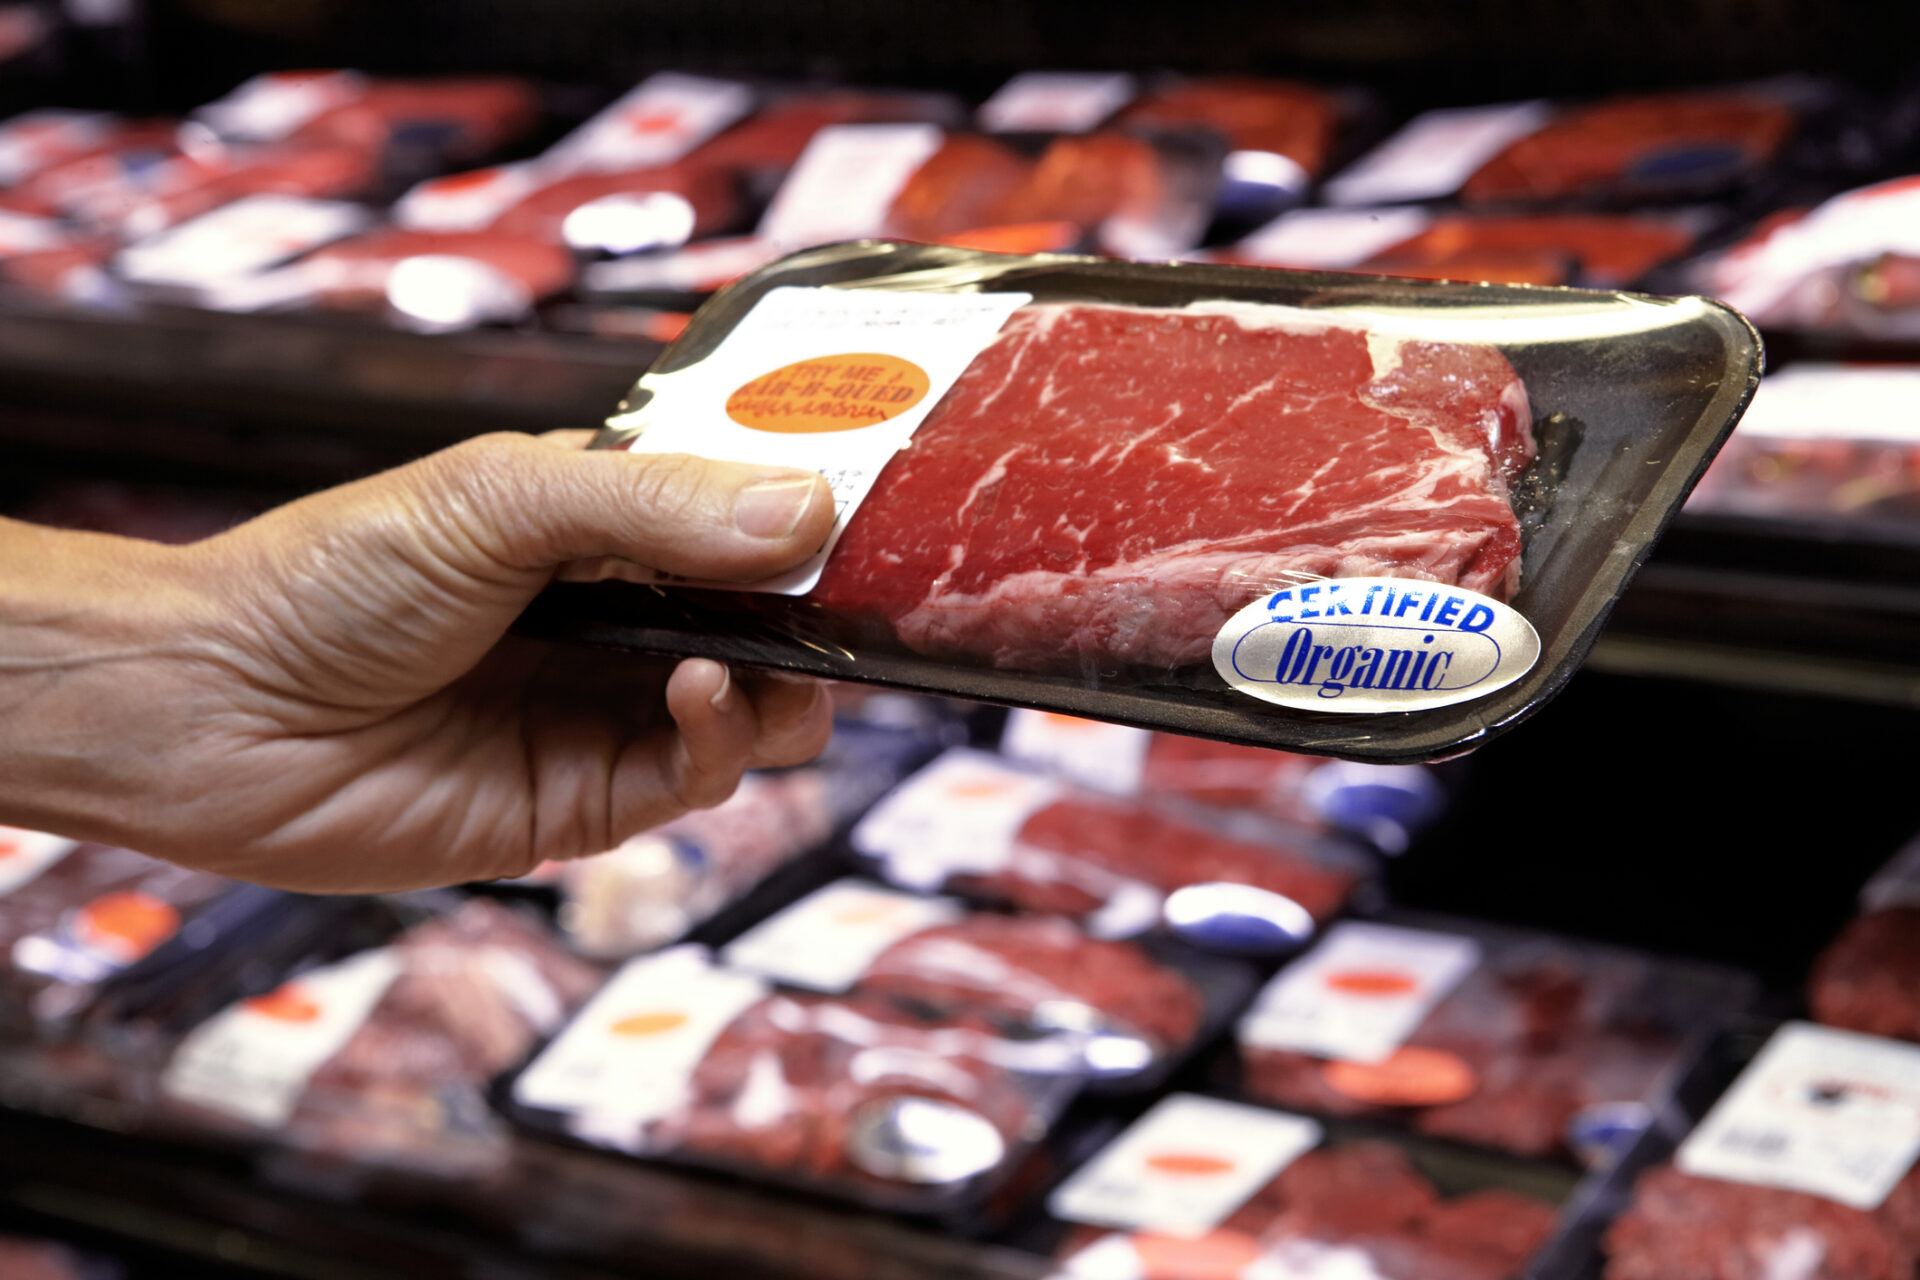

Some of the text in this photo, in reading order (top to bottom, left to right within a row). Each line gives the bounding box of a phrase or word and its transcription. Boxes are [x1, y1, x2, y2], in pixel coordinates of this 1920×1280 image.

[790, 363, 886, 383] TRY ME
[1275, 627, 1454, 699] Organic
